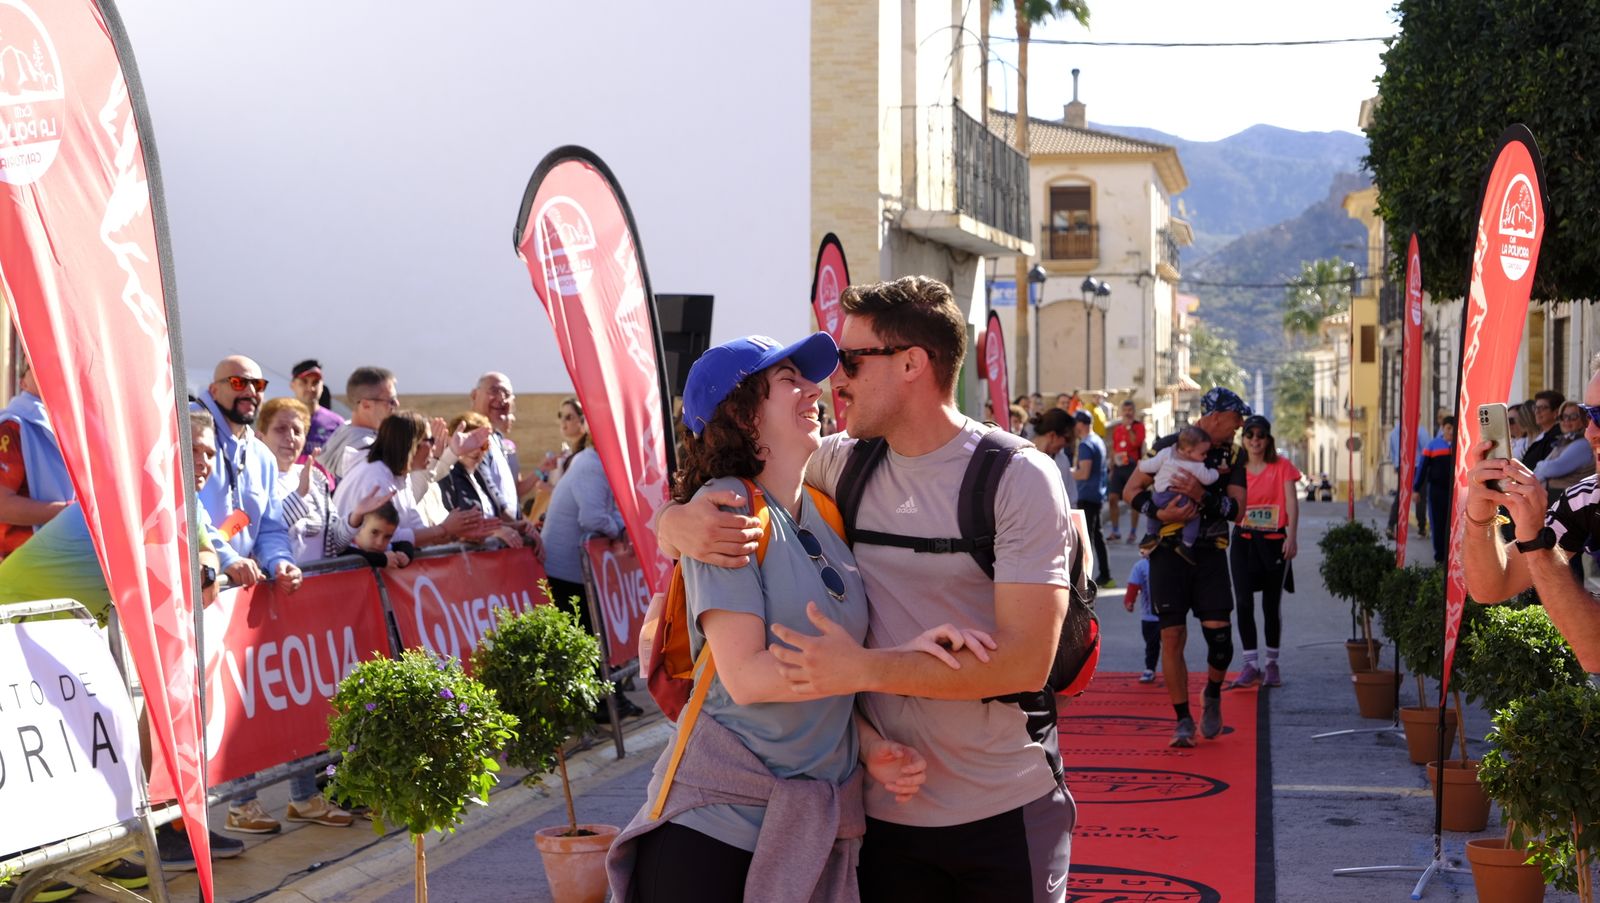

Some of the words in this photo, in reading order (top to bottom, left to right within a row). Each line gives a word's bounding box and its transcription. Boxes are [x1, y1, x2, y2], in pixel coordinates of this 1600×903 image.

[1248, 510, 1272, 520] 419
[0, 679, 45, 713] TO
[59, 672, 97, 702] DE
[225, 625, 360, 720] VEOLIA
[0, 711, 119, 790] RIA
